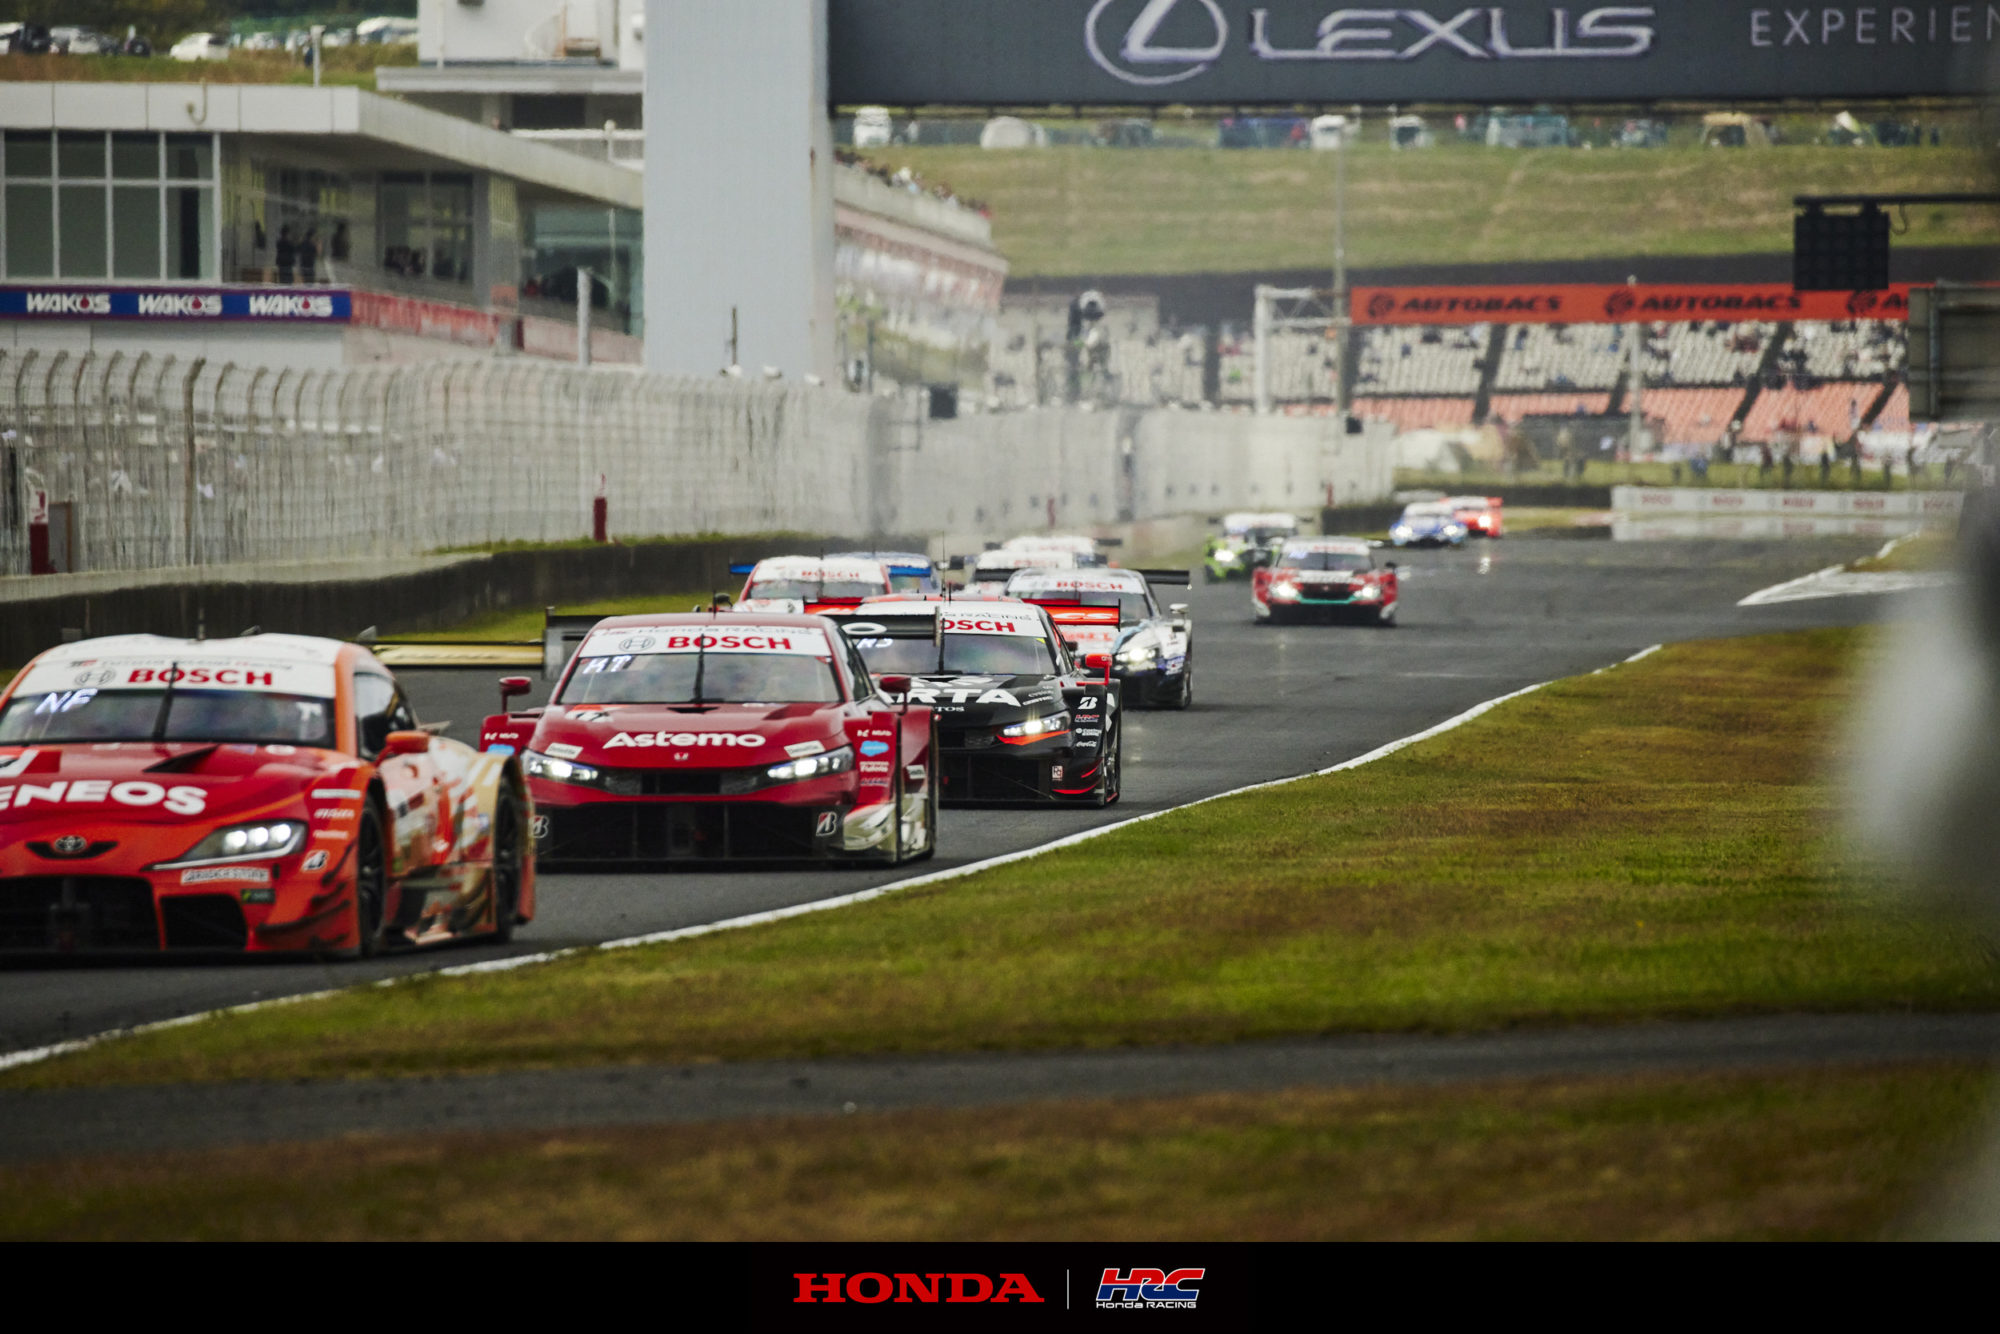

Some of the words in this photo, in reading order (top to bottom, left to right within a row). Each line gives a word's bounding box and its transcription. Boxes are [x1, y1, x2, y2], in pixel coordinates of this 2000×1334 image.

[1252, 6, 1655, 60] LEXUS
[1056, 581, 1123, 590] BOSCH
[939, 619, 1016, 633] OSCH
[667, 636, 792, 650] BOSCH
[127, 669, 273, 686] BOSCH
[602, 731, 766, 749] Astemo
